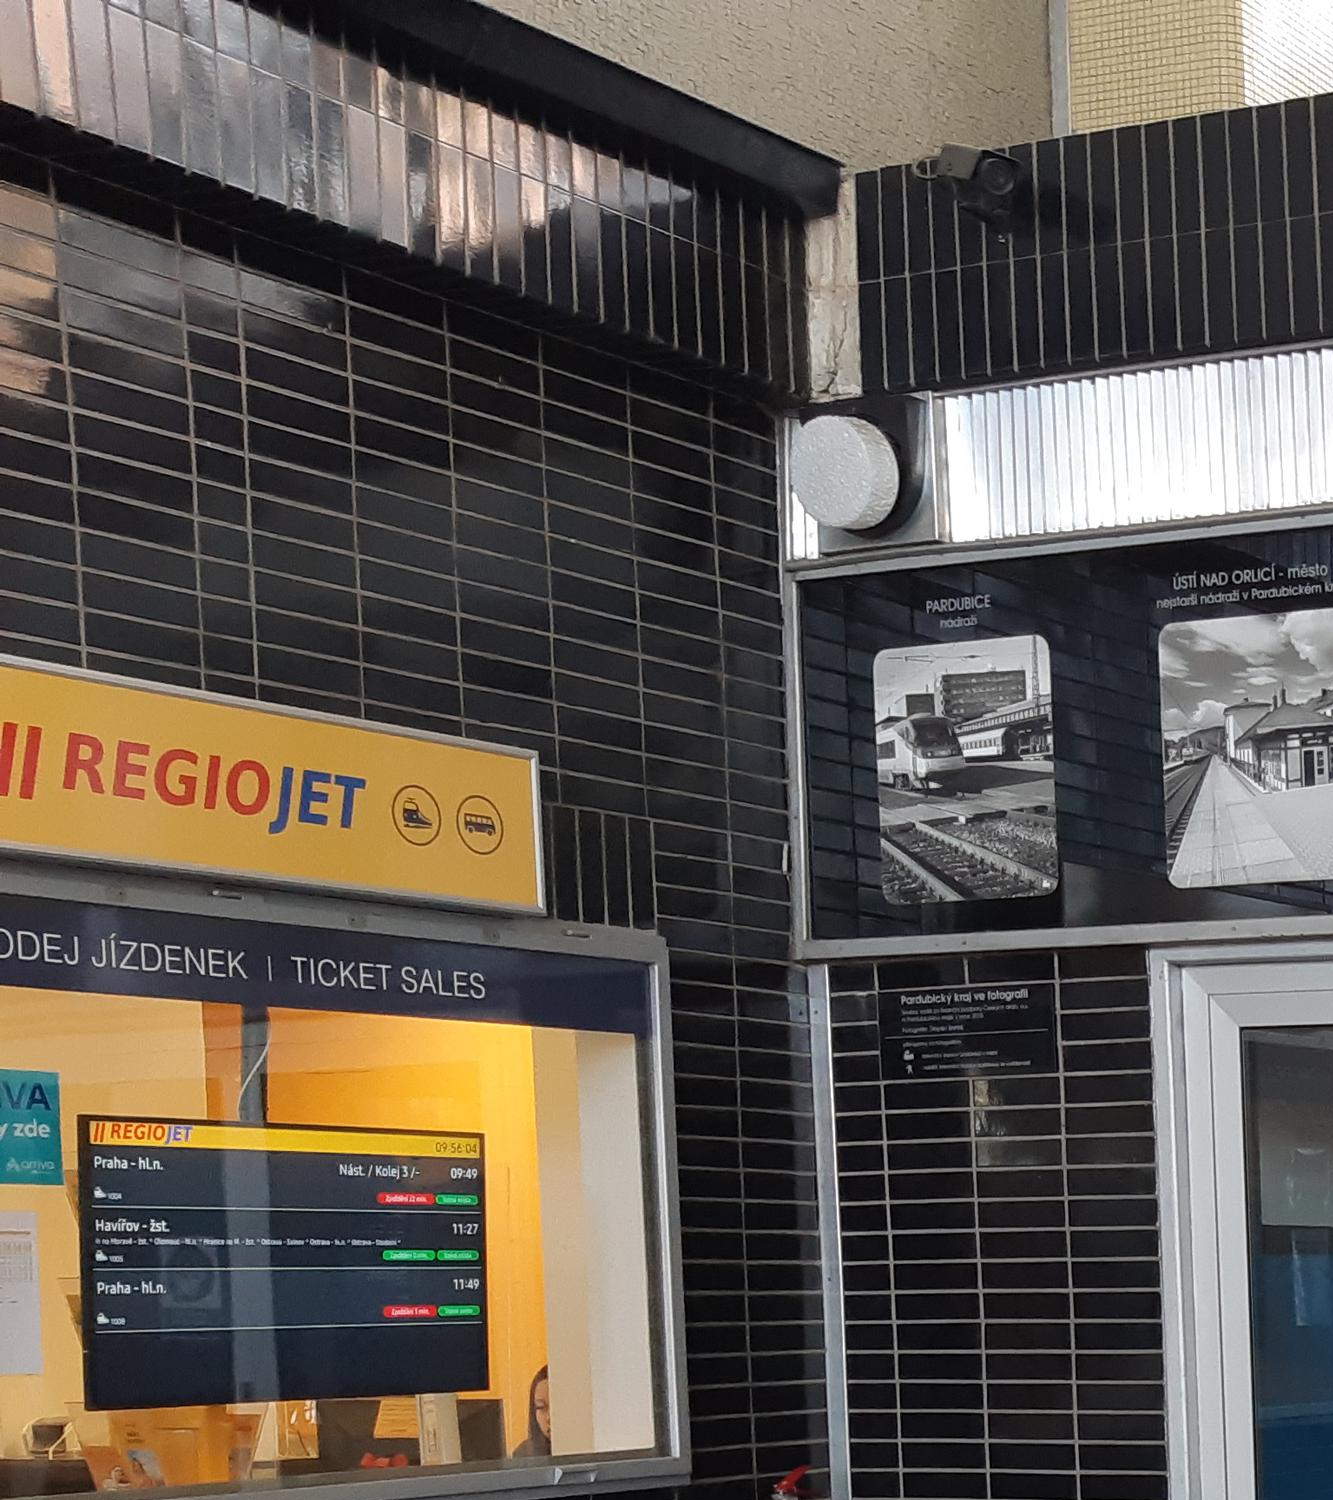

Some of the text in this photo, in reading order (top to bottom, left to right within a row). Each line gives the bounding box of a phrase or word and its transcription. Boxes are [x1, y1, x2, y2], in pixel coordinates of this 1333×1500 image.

[1172, 571, 1197, 590] ÚSTÍ
[1200, 573, 1229, 588] NAD
[1231, 563, 1276, 585] ORLICÍ
[1287, 563, 1328, 579] město
[925, 594, 992, 614] PARDUBICE
[1156, 593, 1198, 610] nejstarší
[1200, 589, 1241, 604] nádraží
[1242, 592, 1250, 600] v
[1251, 582, 1322, 600] Pardubickém
[940, 614, 978, 629] nádraží
[63, 732, 367, 835] REGIOJET
[91, 932, 249, 979] JÍZDENEK
[290, 955, 392, 991] TICKET
[401, 966, 486, 999] SALES
[900, 993, 951, 1006] Pardubický
[953, 990, 972, 1004] kraj
[974, 993, 986, 1001] ve
[13, 1117, 51, 1138] zde
[110, 1123, 193, 1145] REGIOJET
[93, 1155, 128, 1170] Praha
[339, 1163, 366, 1176] Nást.
[375, 1165, 400, 1180] Kolej
[450, 1167, 478, 1180] 09:49
[95, 1218, 140, 1233] Havířov
[149, 1218, 171, 1233] žst.
[452, 1223, 479, 1235] 11:27
[97, 1281, 131, 1295] Praha
[453, 1278, 480, 1290] 11:49
